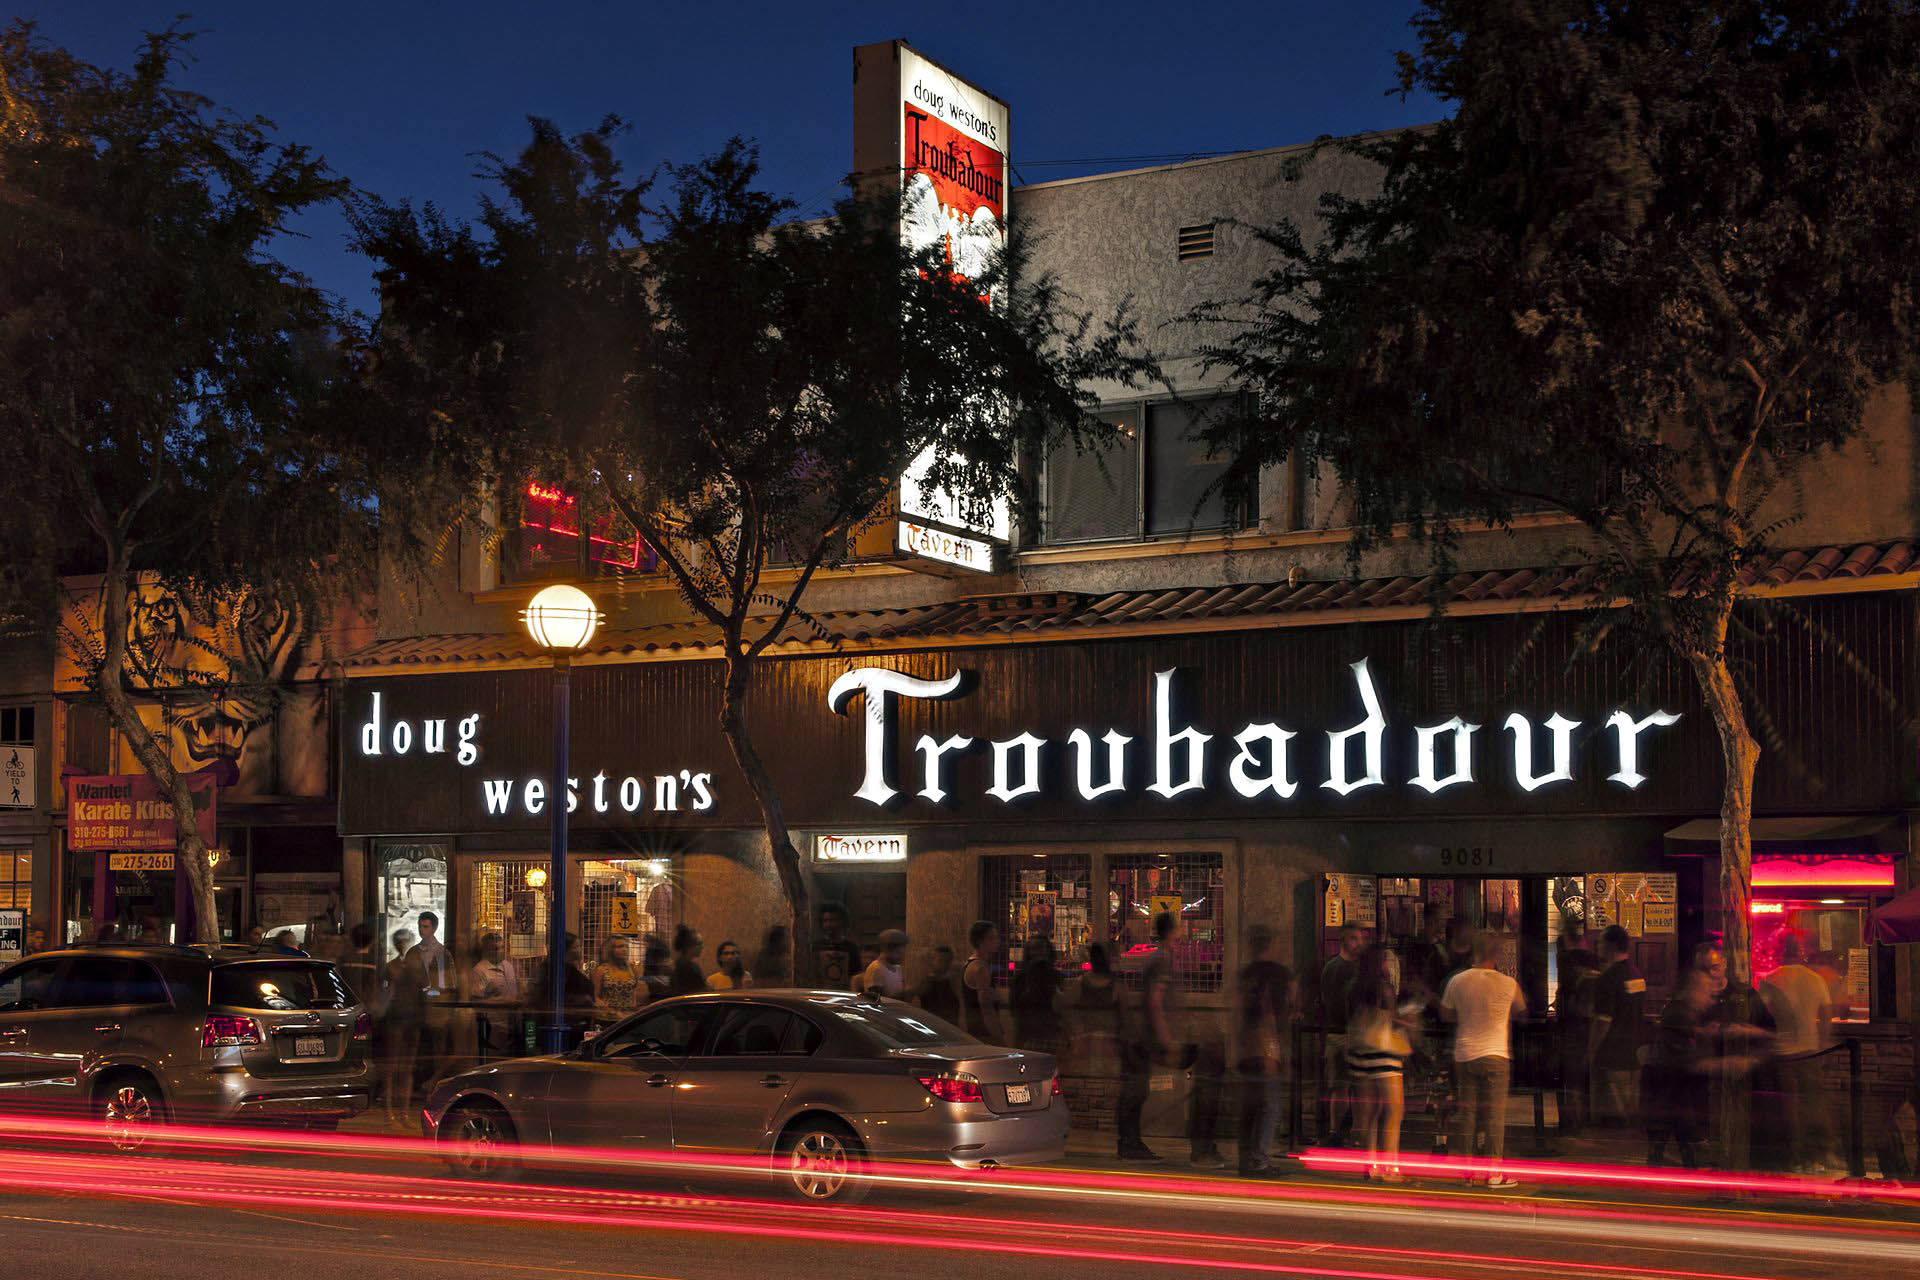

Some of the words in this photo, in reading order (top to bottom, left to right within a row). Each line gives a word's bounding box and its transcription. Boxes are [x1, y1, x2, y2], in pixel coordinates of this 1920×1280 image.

[913, 79, 944, 118] doug
[949, 102, 997, 142] weston's
[907, 110, 1003, 204] Troubadour
[906, 522, 974, 563] Tavern
[361, 691, 481, 766] doug
[828, 655, 1683, 807] Troubadour
[5, 769, 26, 778] YIELD
[11, 777, 20, 785] TO
[75, 783, 132, 799] Wanted
[483, 769, 714, 815] weston's
[74, 801, 132, 821] Karate
[136, 800, 176, 820] Kids
[822, 834, 900, 861] Tavern
[1441, 847, 1493, 866] 9081
[123, 855, 174, 869] 275-2661
